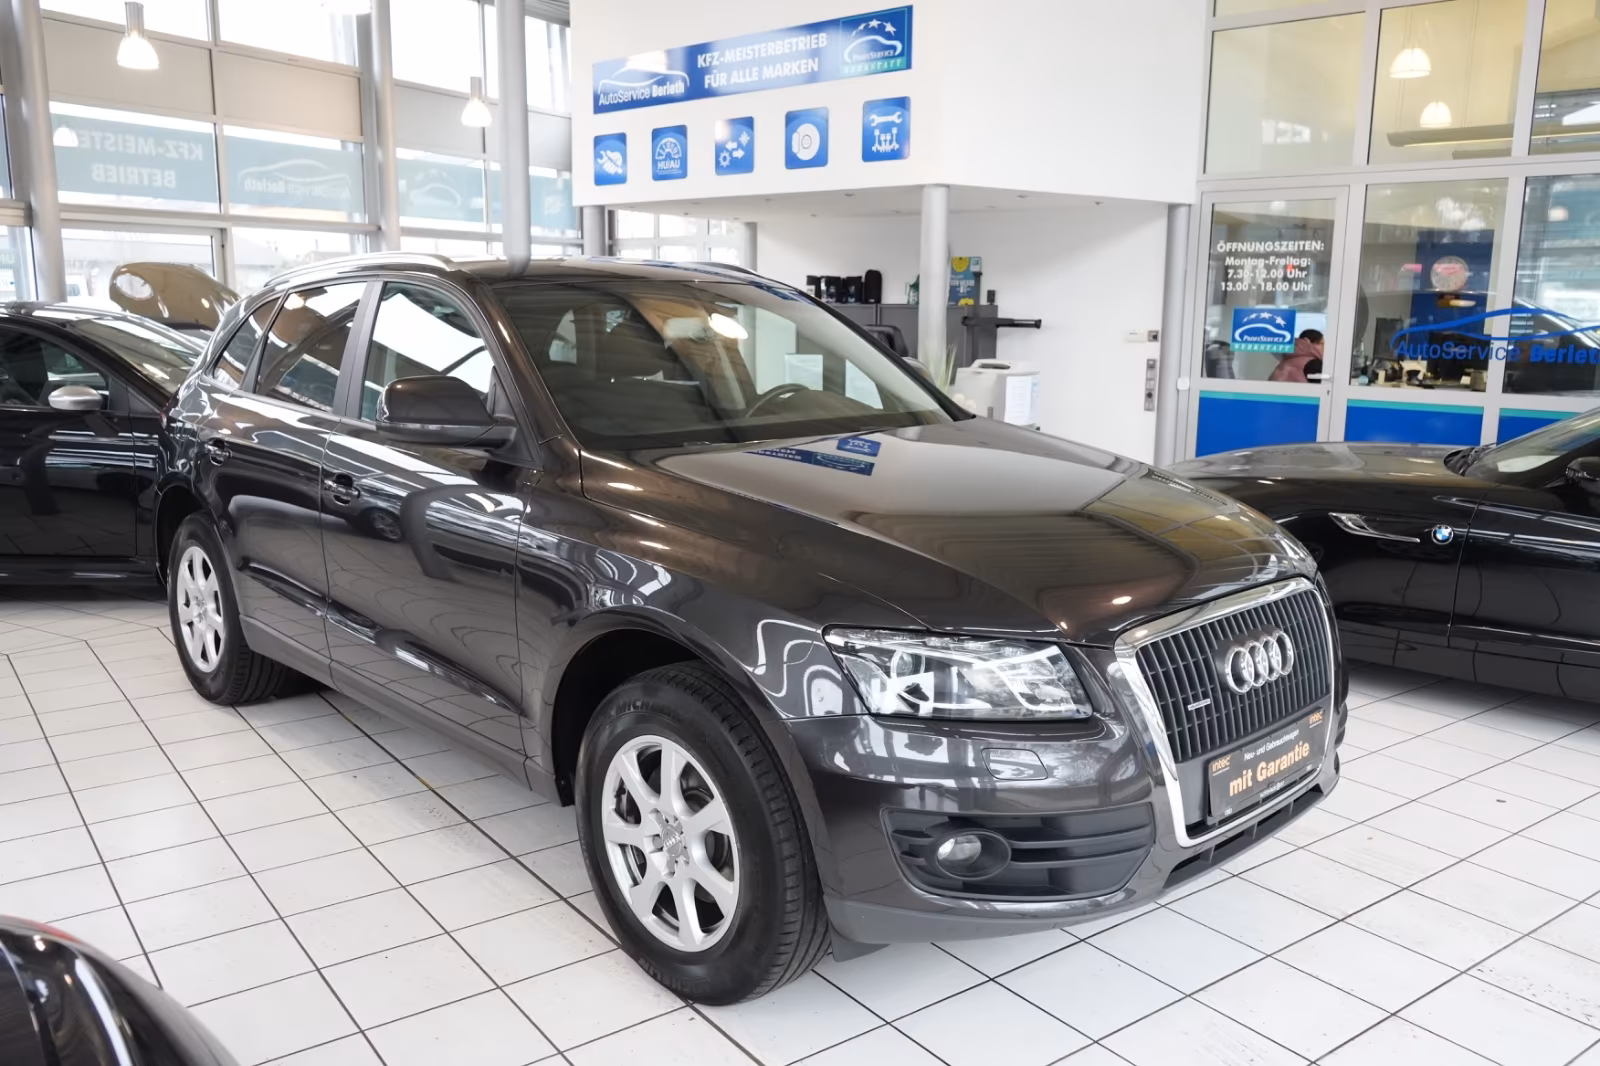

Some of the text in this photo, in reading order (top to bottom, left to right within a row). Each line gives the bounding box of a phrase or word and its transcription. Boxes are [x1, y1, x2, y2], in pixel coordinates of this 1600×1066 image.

[697, 33, 828, 68] KFZ-MEISTERBETRIEB
[704, 58, 819, 88] FÜR ALLE MARKEN
[599, 80, 685, 106] AutoService Berleth
[1217, 240, 1325, 252] ÖFFNUNGSZEITEN:
[1225, 256, 1311, 267] Montag-Freitag:
[1227, 269, 1307, 278] 7.30-12.00 Uhr
[1220, 282, 1248, 291] 13.00
[1260, 282, 1289, 291] 18.00
[1292, 282, 1313, 291] Uhr
[1396, 341, 1600, 364] AutoService Berlet
[1229, 768, 1253, 797] mit
[1256, 741, 1310, 782] Garantie
